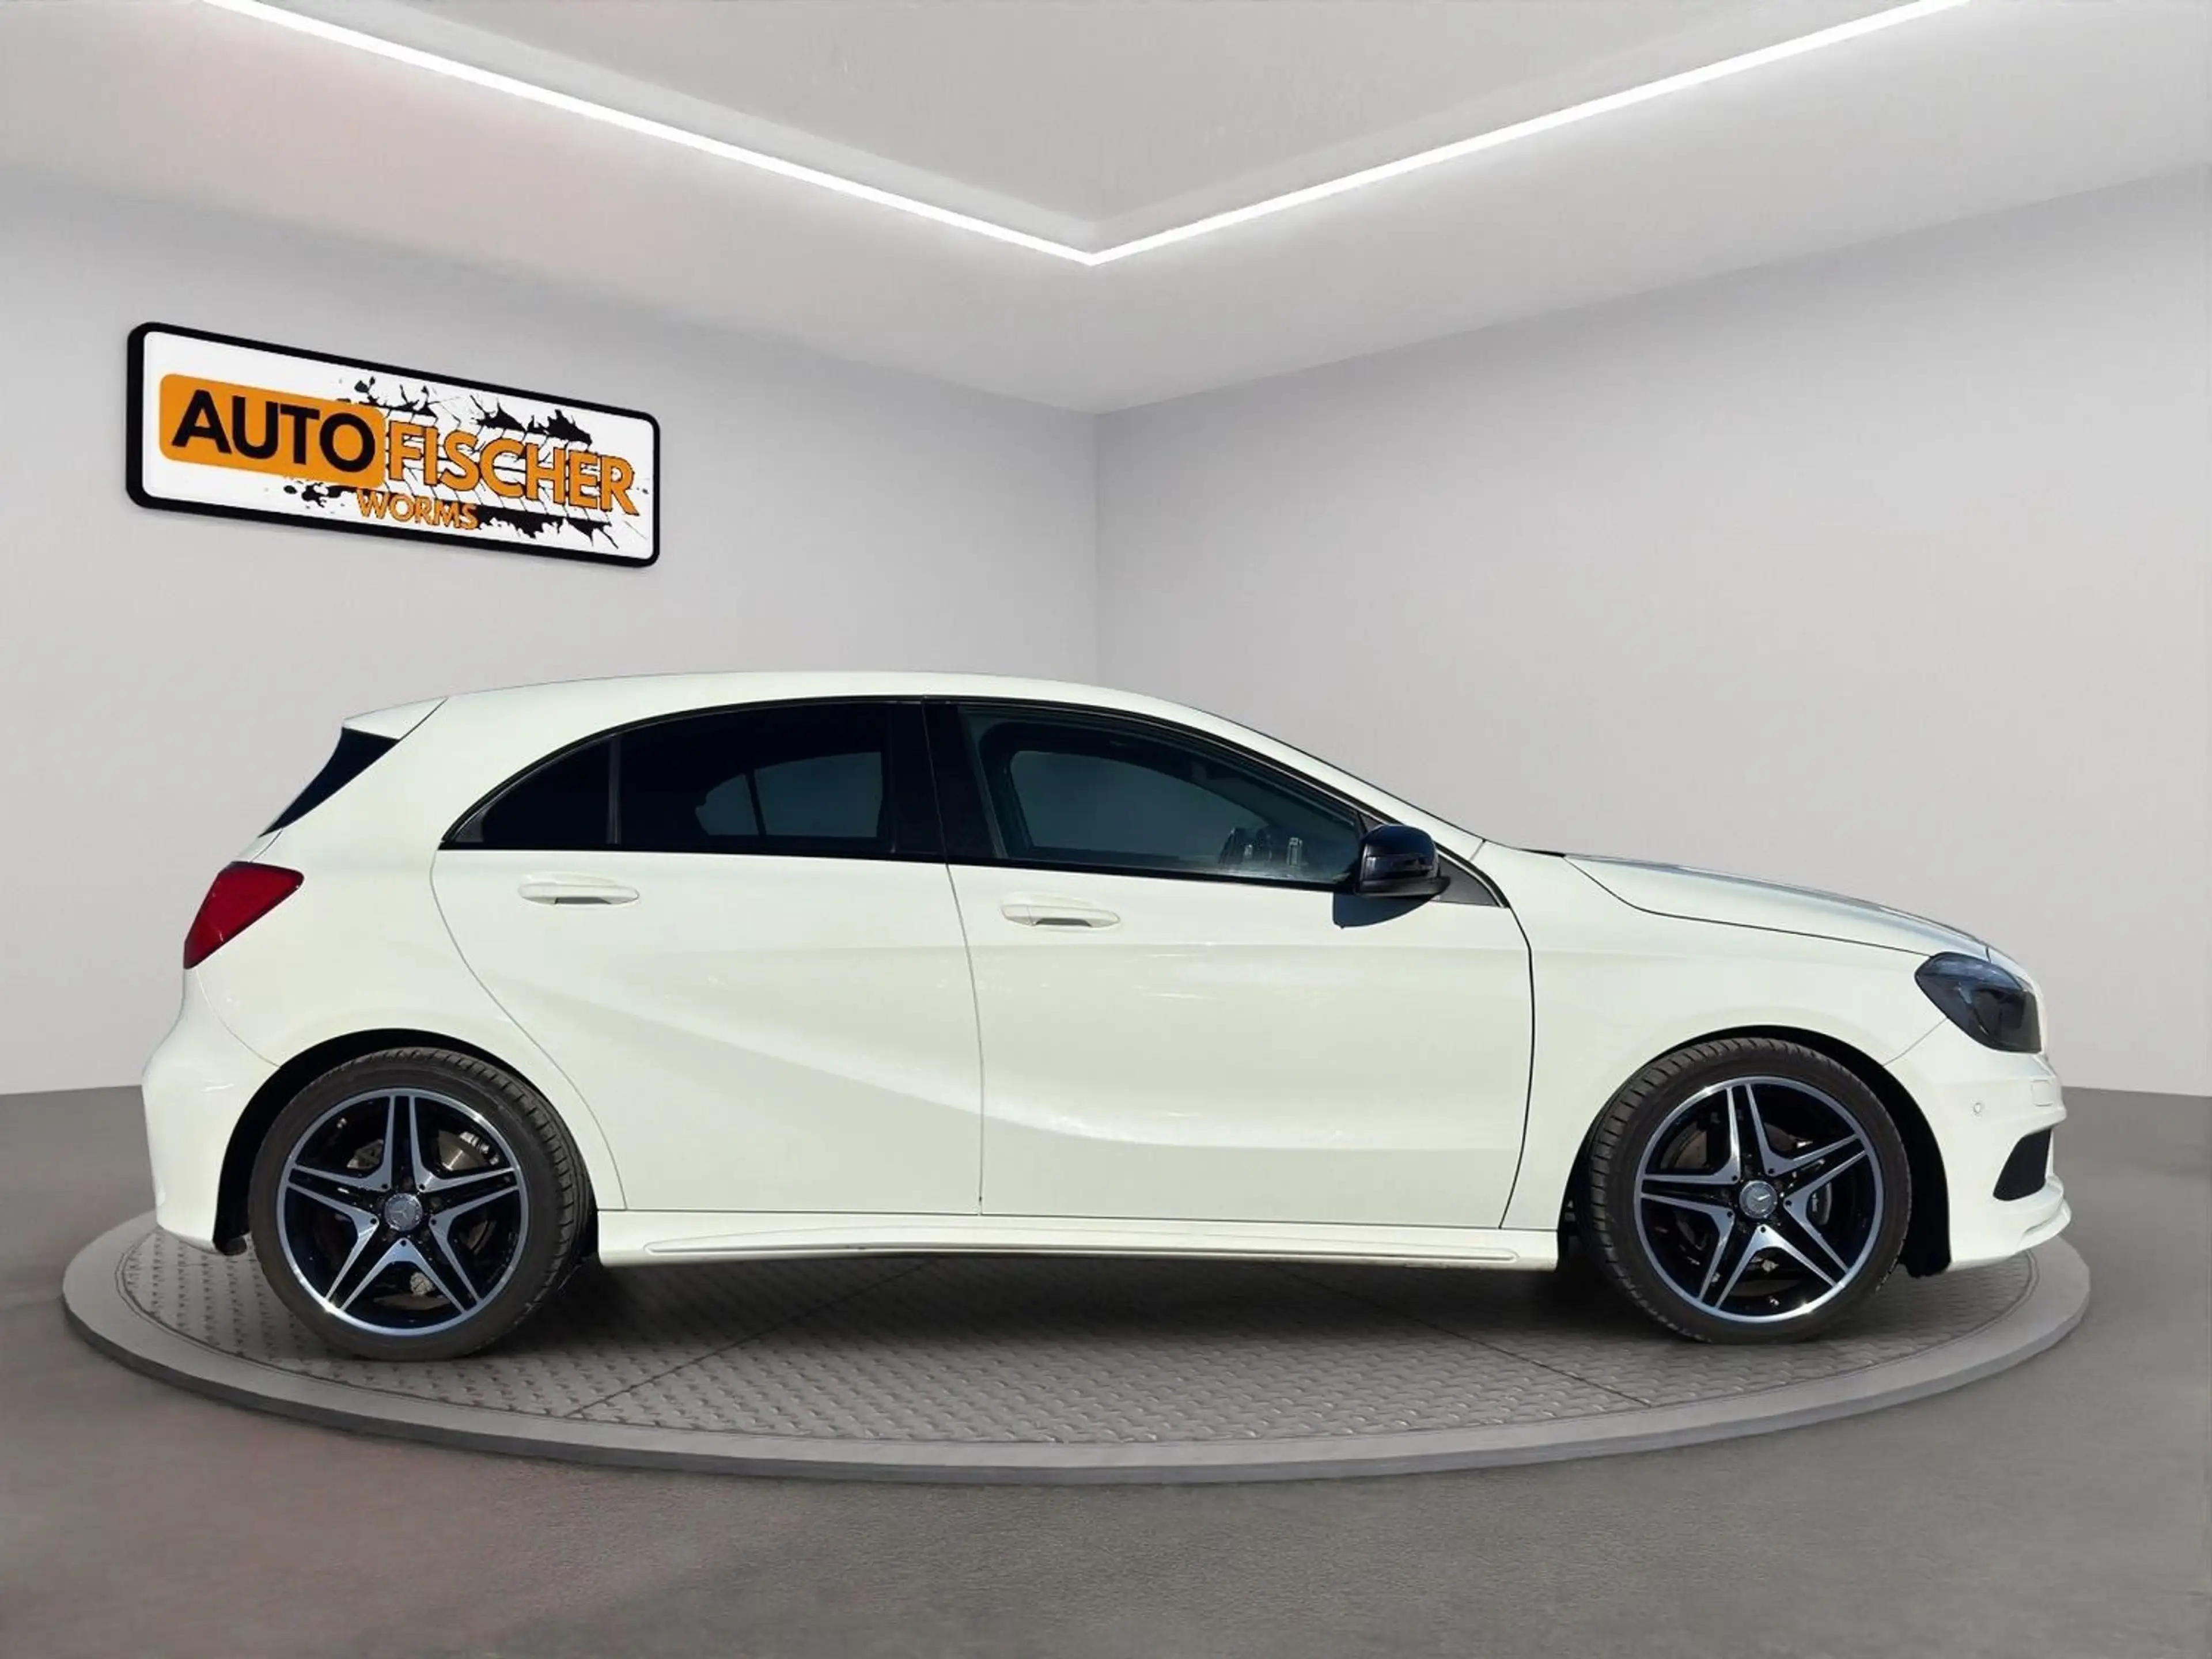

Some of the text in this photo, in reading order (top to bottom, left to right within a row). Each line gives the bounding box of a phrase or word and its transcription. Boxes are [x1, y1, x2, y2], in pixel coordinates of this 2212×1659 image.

[172, 389, 640, 516] AUTO FISCHER
[357, 490, 478, 529] WORMS
